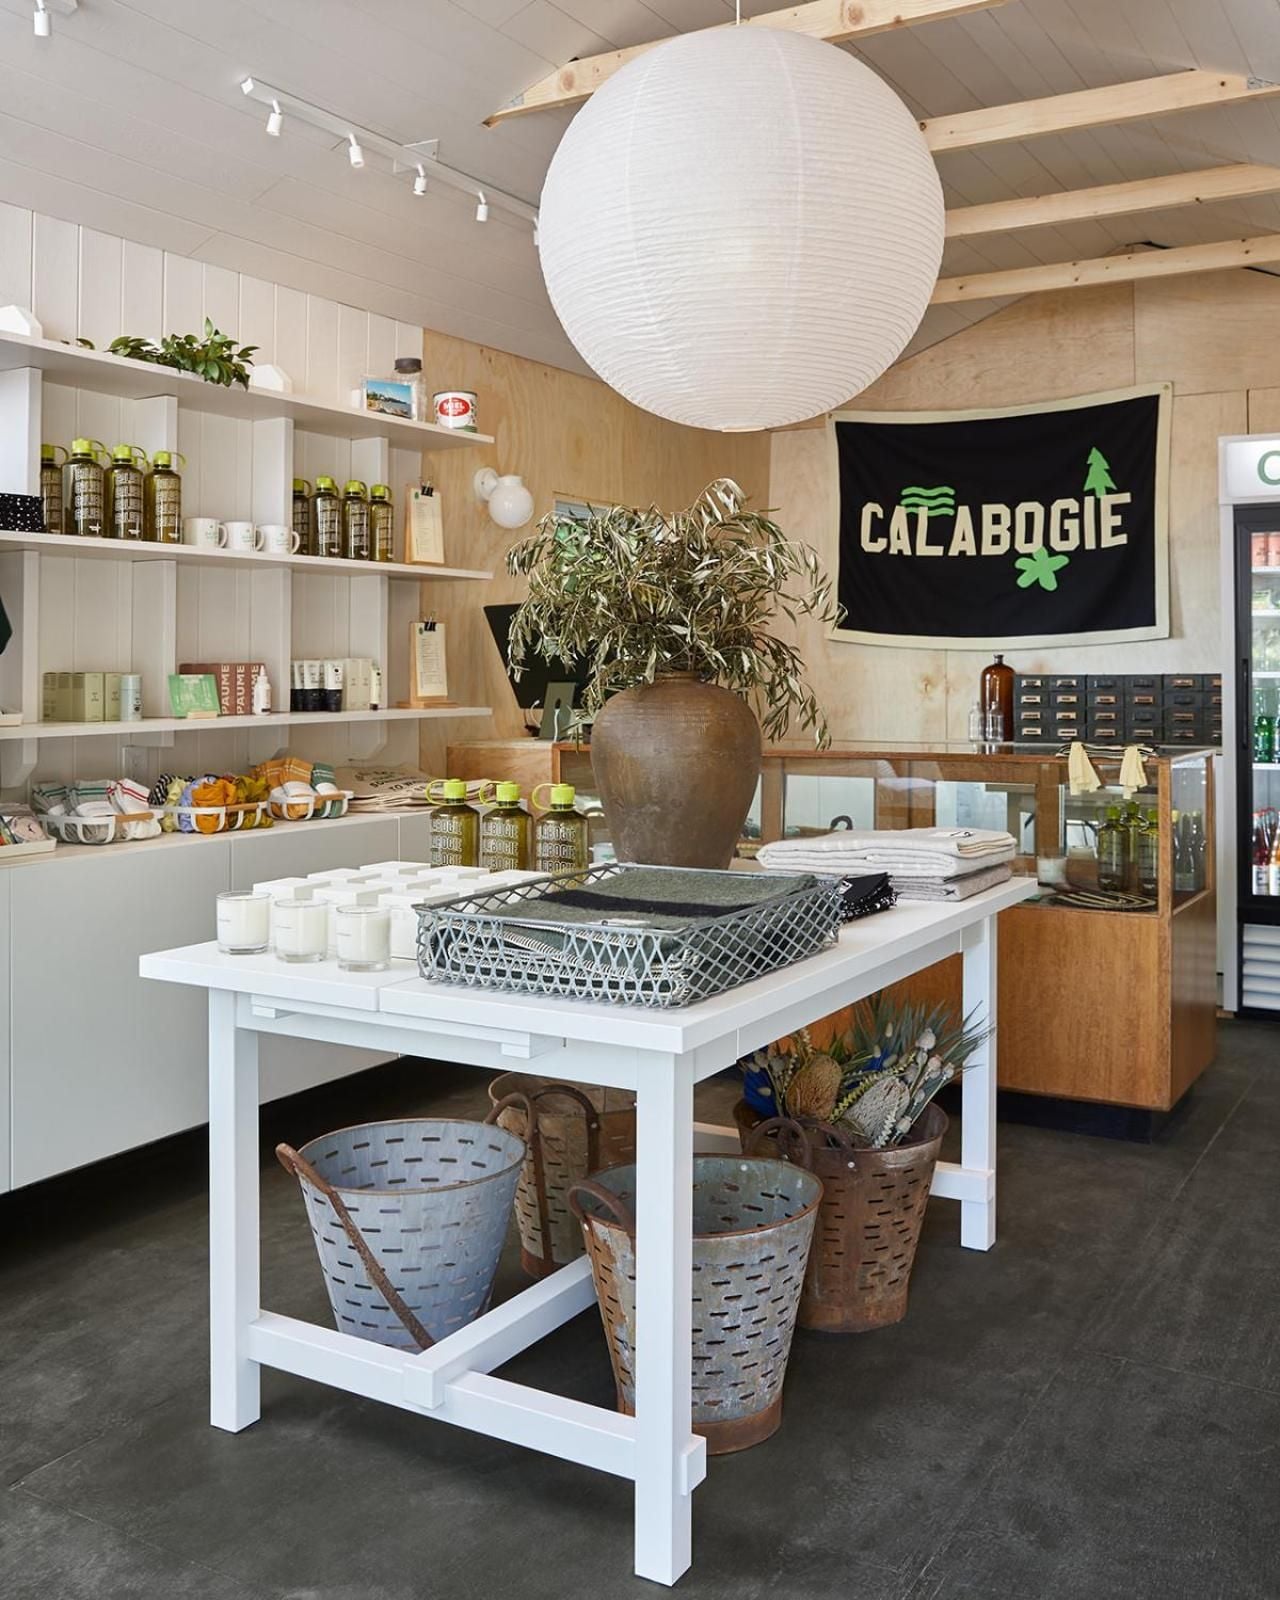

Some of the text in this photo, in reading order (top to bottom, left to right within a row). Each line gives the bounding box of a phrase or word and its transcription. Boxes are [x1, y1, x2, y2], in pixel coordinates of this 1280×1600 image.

[860, 492, 1132, 556] CALABOGIE
[221, 664, 230, 714] PAUME
[236, 664, 245, 714] PAUME
